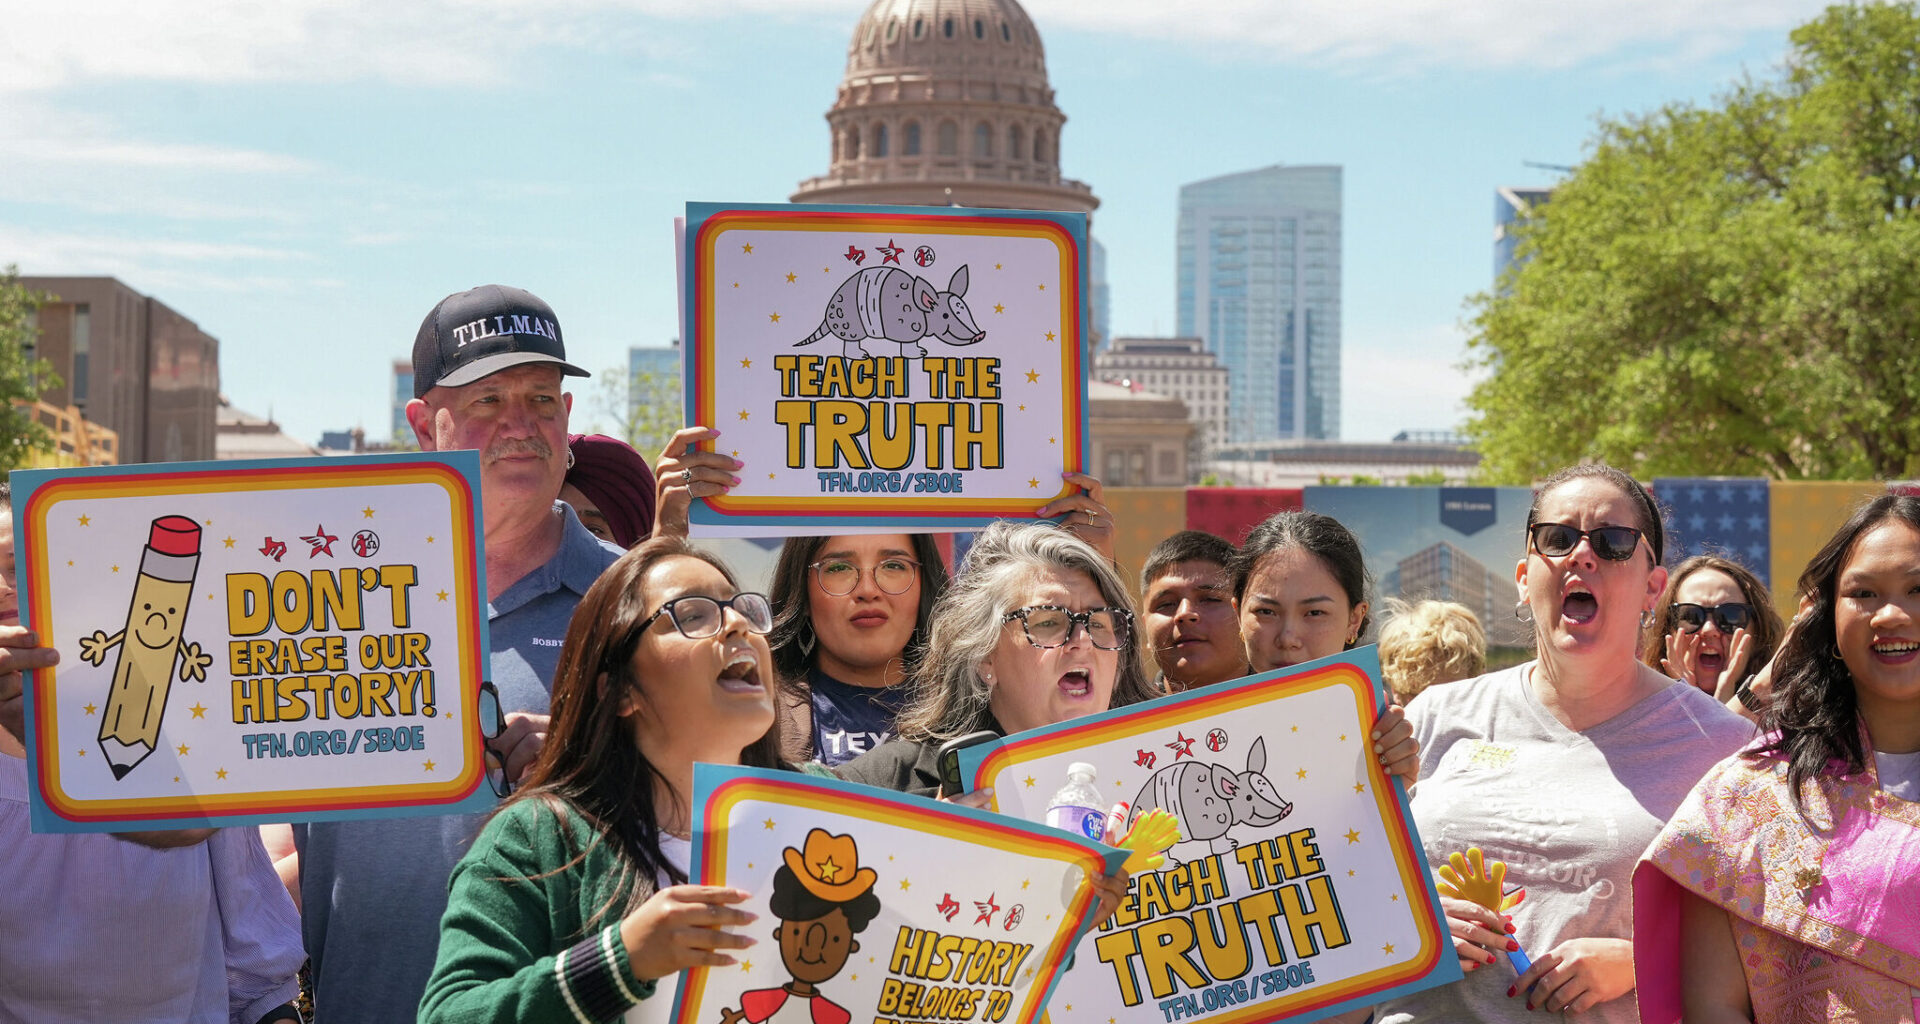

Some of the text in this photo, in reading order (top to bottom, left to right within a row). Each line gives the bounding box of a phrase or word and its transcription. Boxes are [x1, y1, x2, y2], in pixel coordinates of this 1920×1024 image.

[453, 315, 558, 348] TILLMAN
[774, 355, 1002, 399] TEACH THE
[775, 400, 1004, 470] TRUTH
[818, 472, 963, 493] TFN.ORG/SBOE
[226, 564, 418, 637] DON'T
[229, 633, 431, 677] ERASE OUR
[532, 637, 565, 647] BOBBY
[231, 669, 437, 724] HISTORY!
[242, 726, 425, 760] TFN.ORG/SBOE
[1099, 828, 1326, 931] EACH THE
[889, 925, 1034, 987] HISTORY
[1095, 875, 1352, 1007] TRUTH
[877, 978, 1013, 1023] BELONGS TO
[1159, 961, 1316, 1023] TFN.ORG/SBOE
